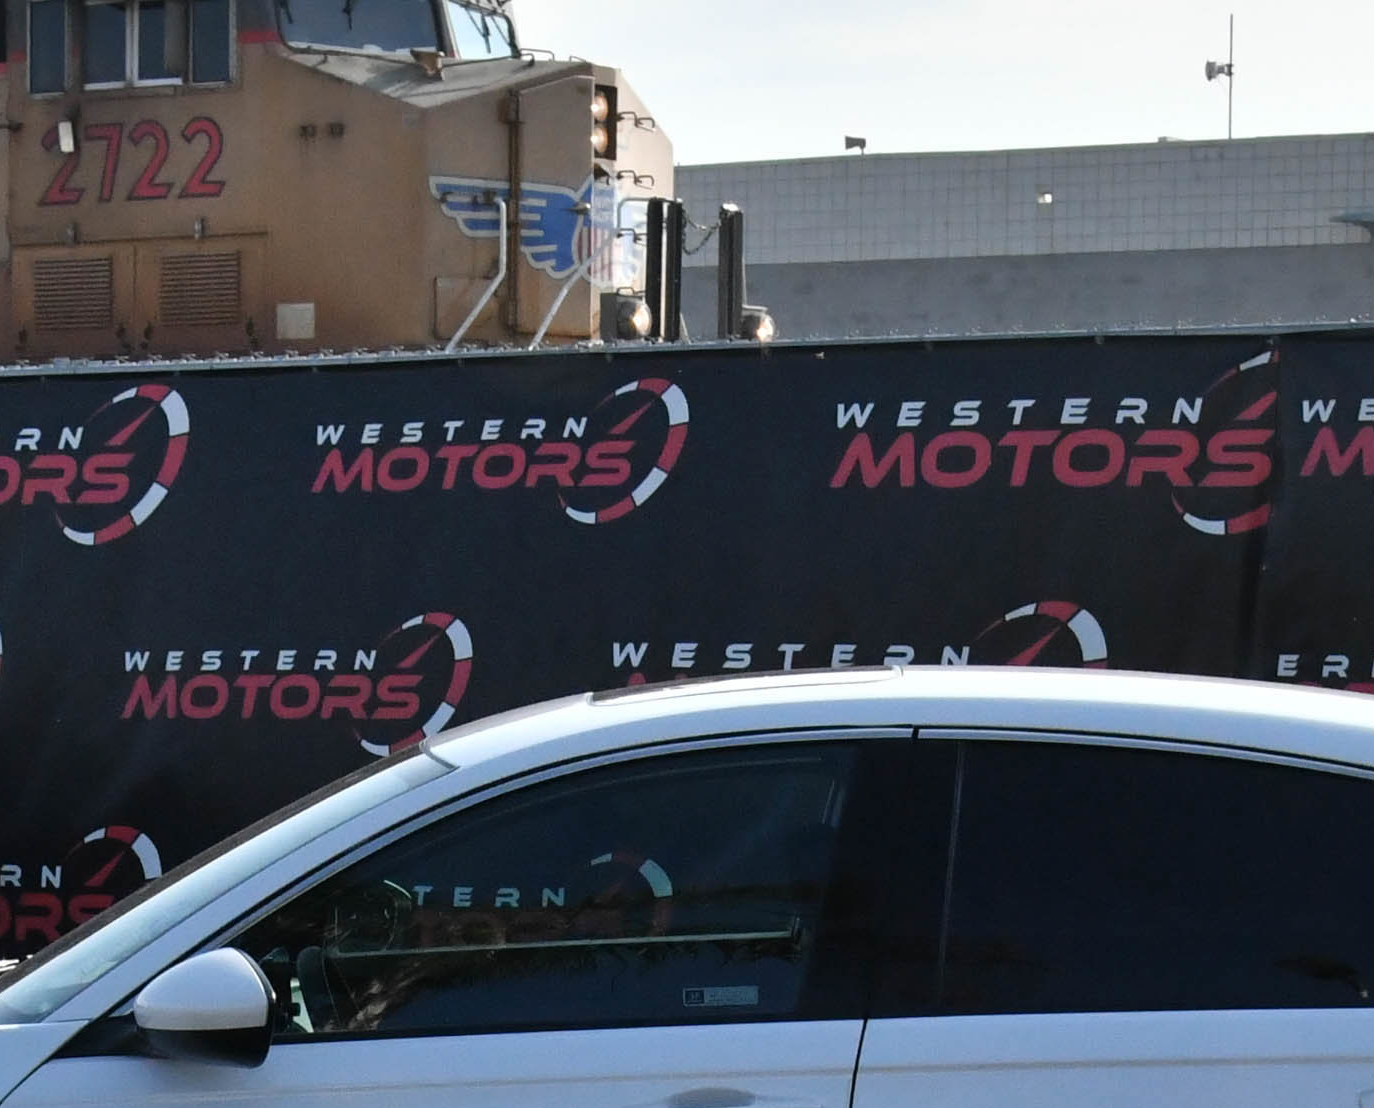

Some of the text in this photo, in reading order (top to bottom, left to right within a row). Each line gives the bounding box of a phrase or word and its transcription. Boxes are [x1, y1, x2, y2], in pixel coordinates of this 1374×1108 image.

[37, 116, 226, 207] 2722
[836, 397, 1203, 429] WESTERN
[316, 416, 588, 446] WESTERN
[311, 440, 635, 492] MOTORS
[830, 427, 1274, 489] MOTORS
[123, 649, 377, 672] WESTERN
[611, 642, 970, 672] WESTERN
[121, 673, 423, 720] MOTORS
[413, 885, 565, 907] TERN
